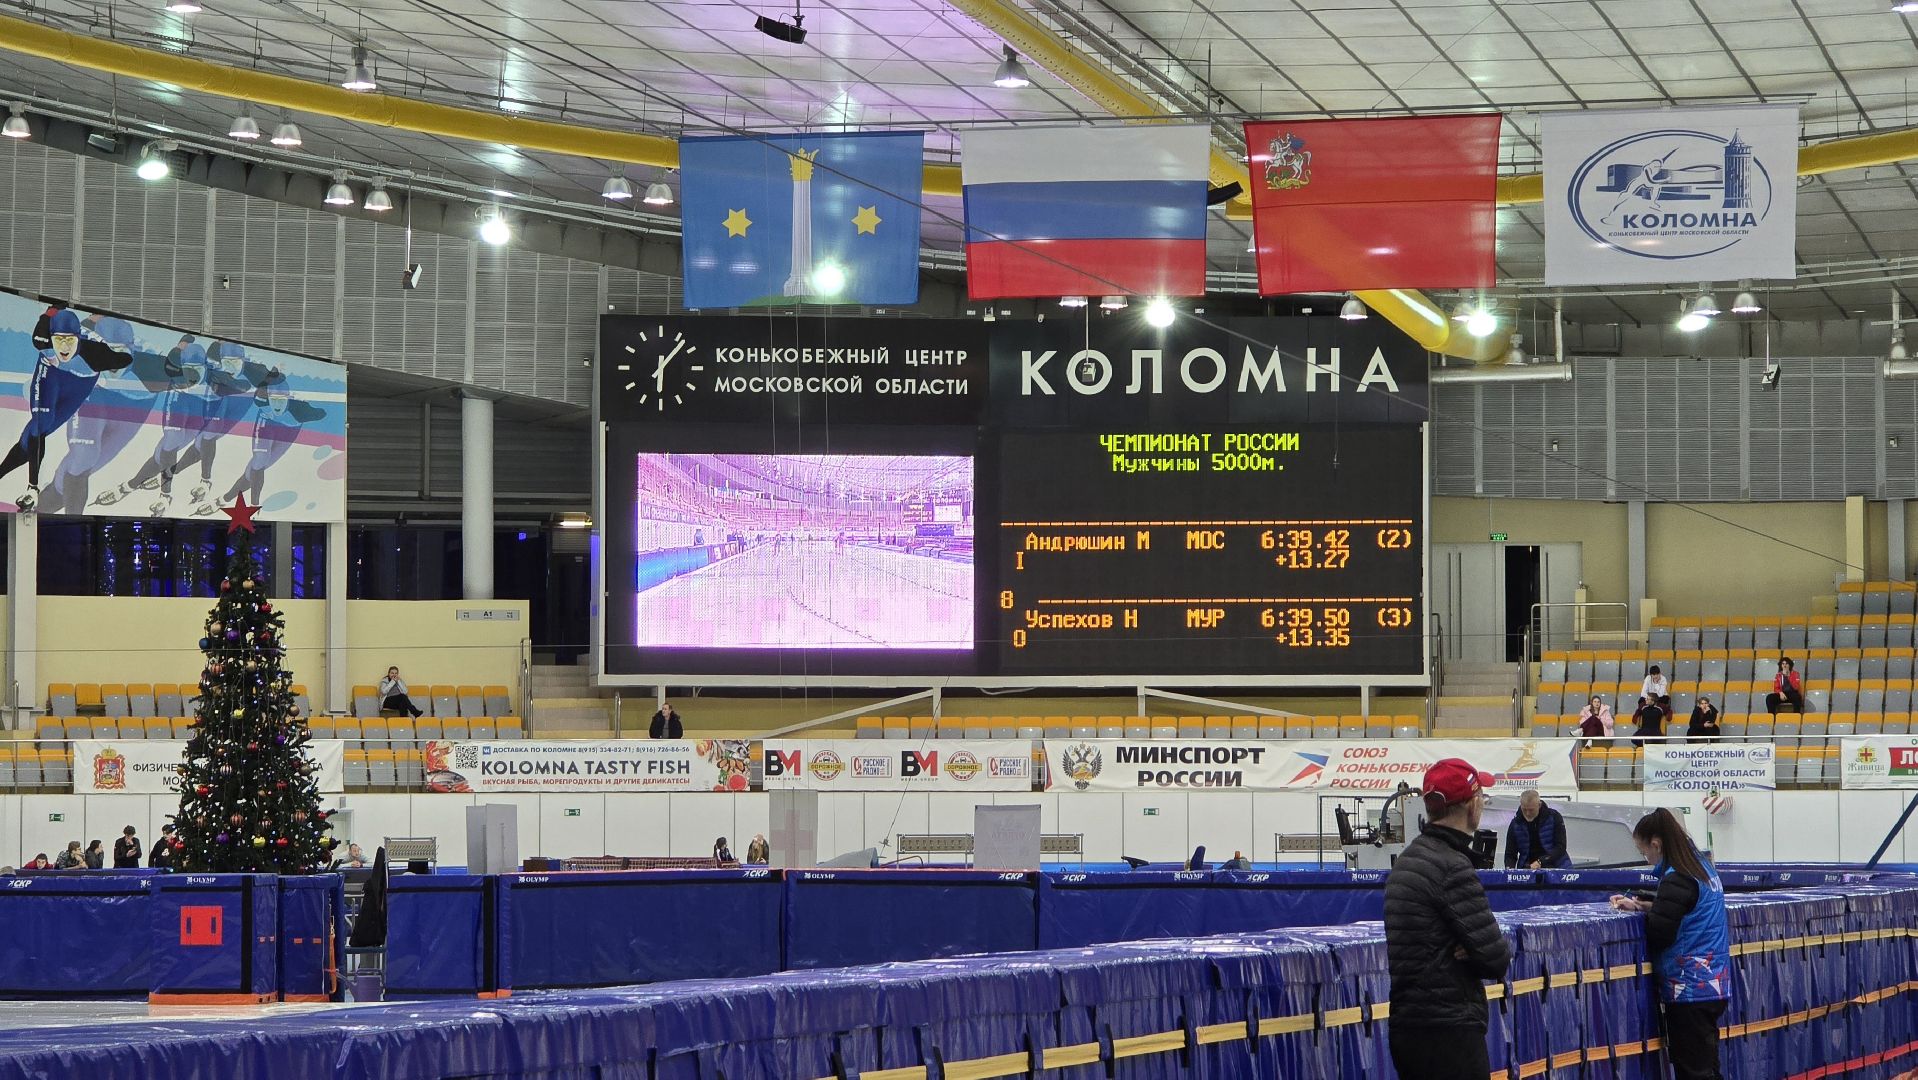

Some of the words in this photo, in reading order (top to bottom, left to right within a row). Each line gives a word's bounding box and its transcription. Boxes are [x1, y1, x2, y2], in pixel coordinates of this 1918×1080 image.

[1623, 212, 1757, 228] КОЛОМНА
[715, 346, 890, 364] КОНЬКОБЕЖНЫЙ
[905, 350, 968, 367] ЦЕНТР
[1022, 344, 1400, 396] КОЛОМНА
[714, 375, 862, 394] МОСКОВСКОЙ
[876, 378, 968, 395] ОБЛАСТИ
[1100, 434, 1212, 452] ЧЕМПИОНАТ
[1224, 432, 1300, 451] РОССИИ
[1112, 455, 1200, 472] Мужчины
[1212, 454, 1284, 472] 5000м.
[1026, 532, 1126, 552] Андрюшин
[1136, 531, 1150, 550] М
[1186, 530, 1226, 550] МОС
[1261, 530, 1350, 549] 6:39.42
[1377, 529, 1412, 548] (2)
[1276, 550, 1350, 568] +13.27
[1000, 590, 1014, 609] 8
[1026, 609, 1113, 628] Успехов
[1124, 608, 1138, 628] Н
[1186, 608, 1226, 628] МУР
[1261, 608, 1350, 628] 6:39.50
[1377, 608, 1412, 627] (3)
[1276, 628, 1350, 646] +13.35
[1116, 746, 1266, 764] МИНСПОРТ
[1343, 747, 1388, 759] СОЮЗ
[1665, 749, 1745, 759] КОНЬКОБЕЖНЫЙ
[482, 760, 580, 775] KOLOMNA
[584, 760, 642, 774] TASTY
[648, 760, 690, 774] FISH
[1336, 763, 1433, 774] КОНЬКОБЕЖ
[1654, 768, 1720, 778] МОСКОВСКОЙ
[1848, 763, 1885, 772] Живица
[1138, 770, 1242, 787] РОССИИ
[1330, 778, 1391, 790] РОССИИ
